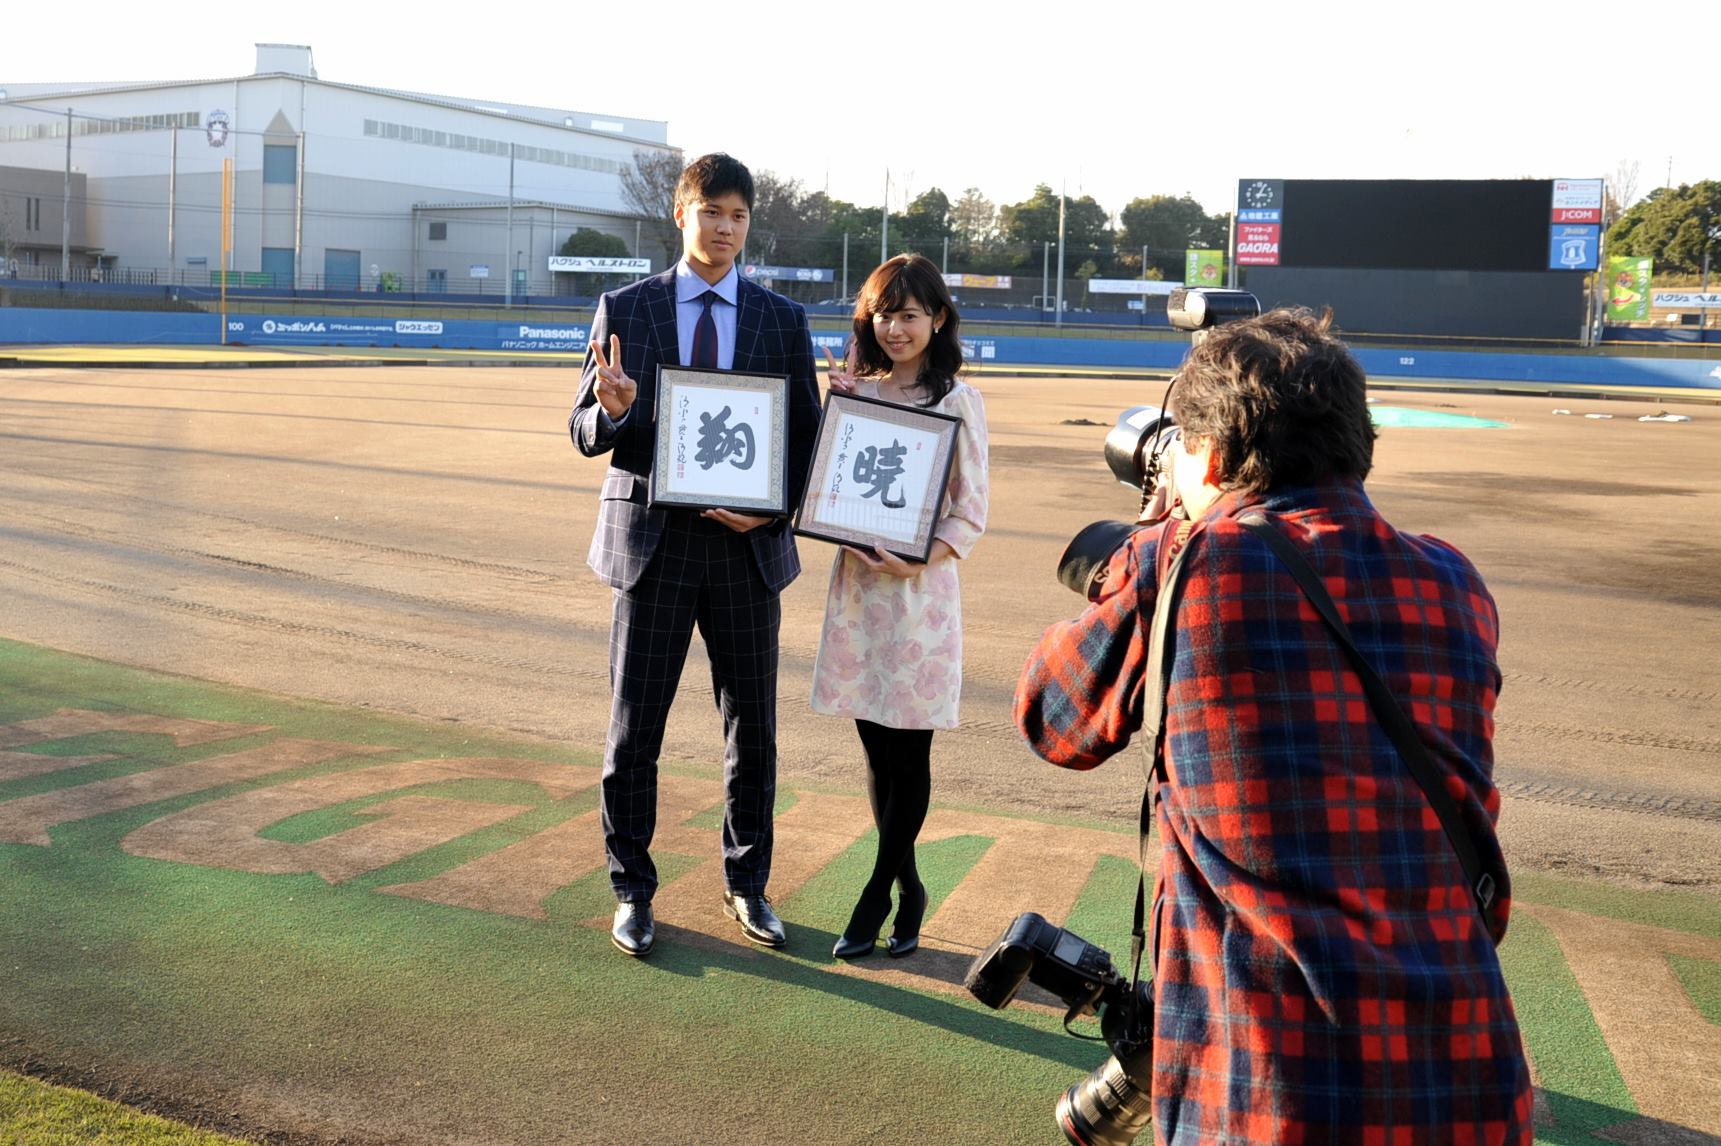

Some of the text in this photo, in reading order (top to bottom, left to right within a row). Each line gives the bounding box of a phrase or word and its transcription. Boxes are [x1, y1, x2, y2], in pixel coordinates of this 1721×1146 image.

[1237, 242, 1279, 254] GAORA
[585, 259, 647, 268] ヘルストロン
[228, 322, 245, 331] 100
[519, 326, 585, 339] Panasonic
[501, 340, 537, 349] パナソニック
[694, 405, 756, 471] 翔
[853, 437, 908, 508] 暁
